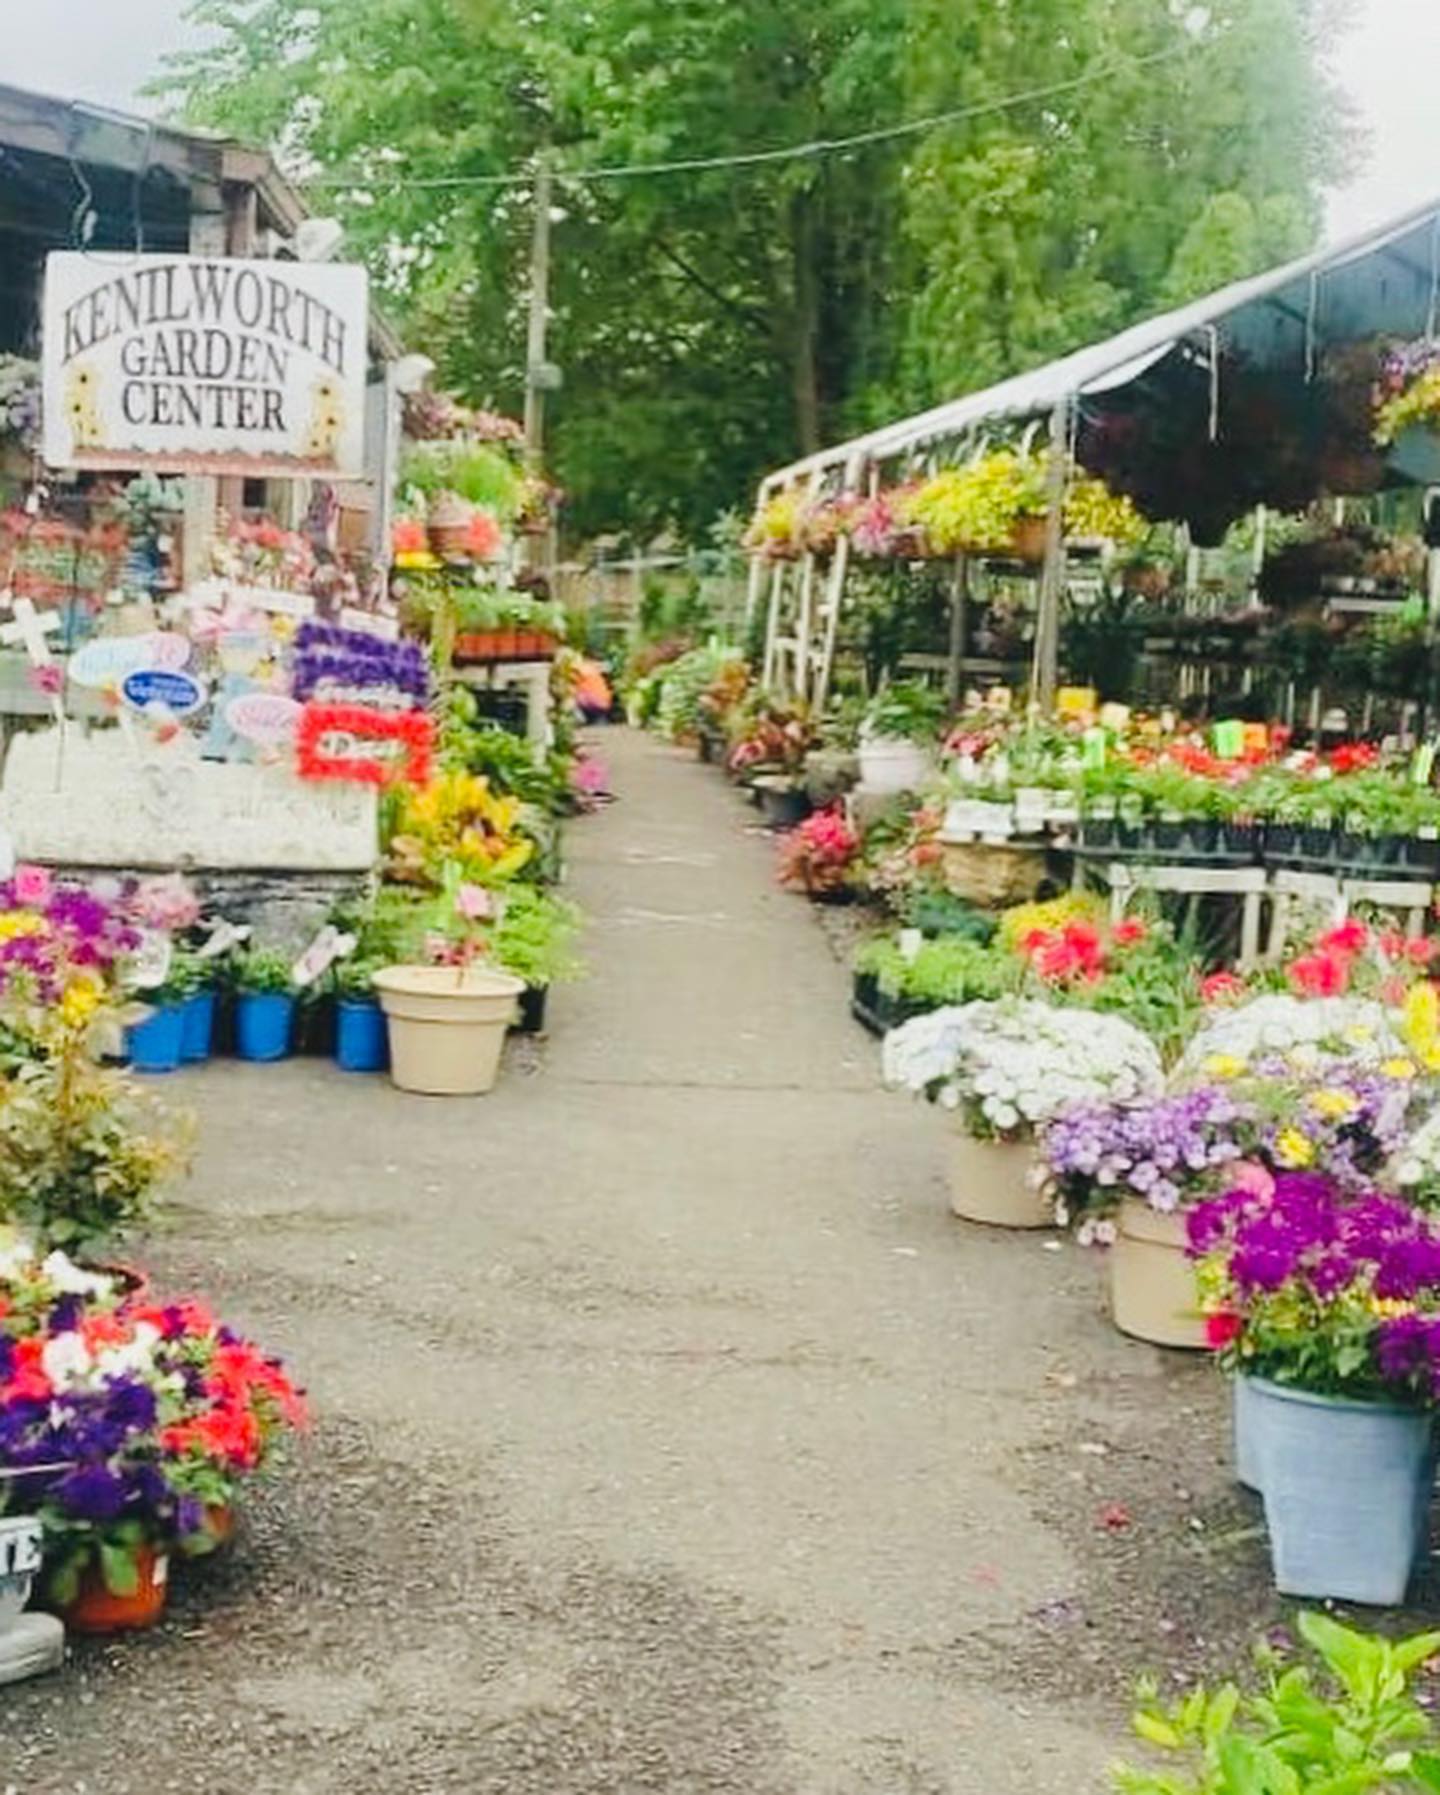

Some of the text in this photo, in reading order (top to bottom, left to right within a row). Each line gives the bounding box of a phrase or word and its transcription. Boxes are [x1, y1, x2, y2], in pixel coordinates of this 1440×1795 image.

[62, 264, 346, 377] KENILWORTH
[121, 329, 289, 382] GARDEN
[122, 380, 287, 432] CENTER
